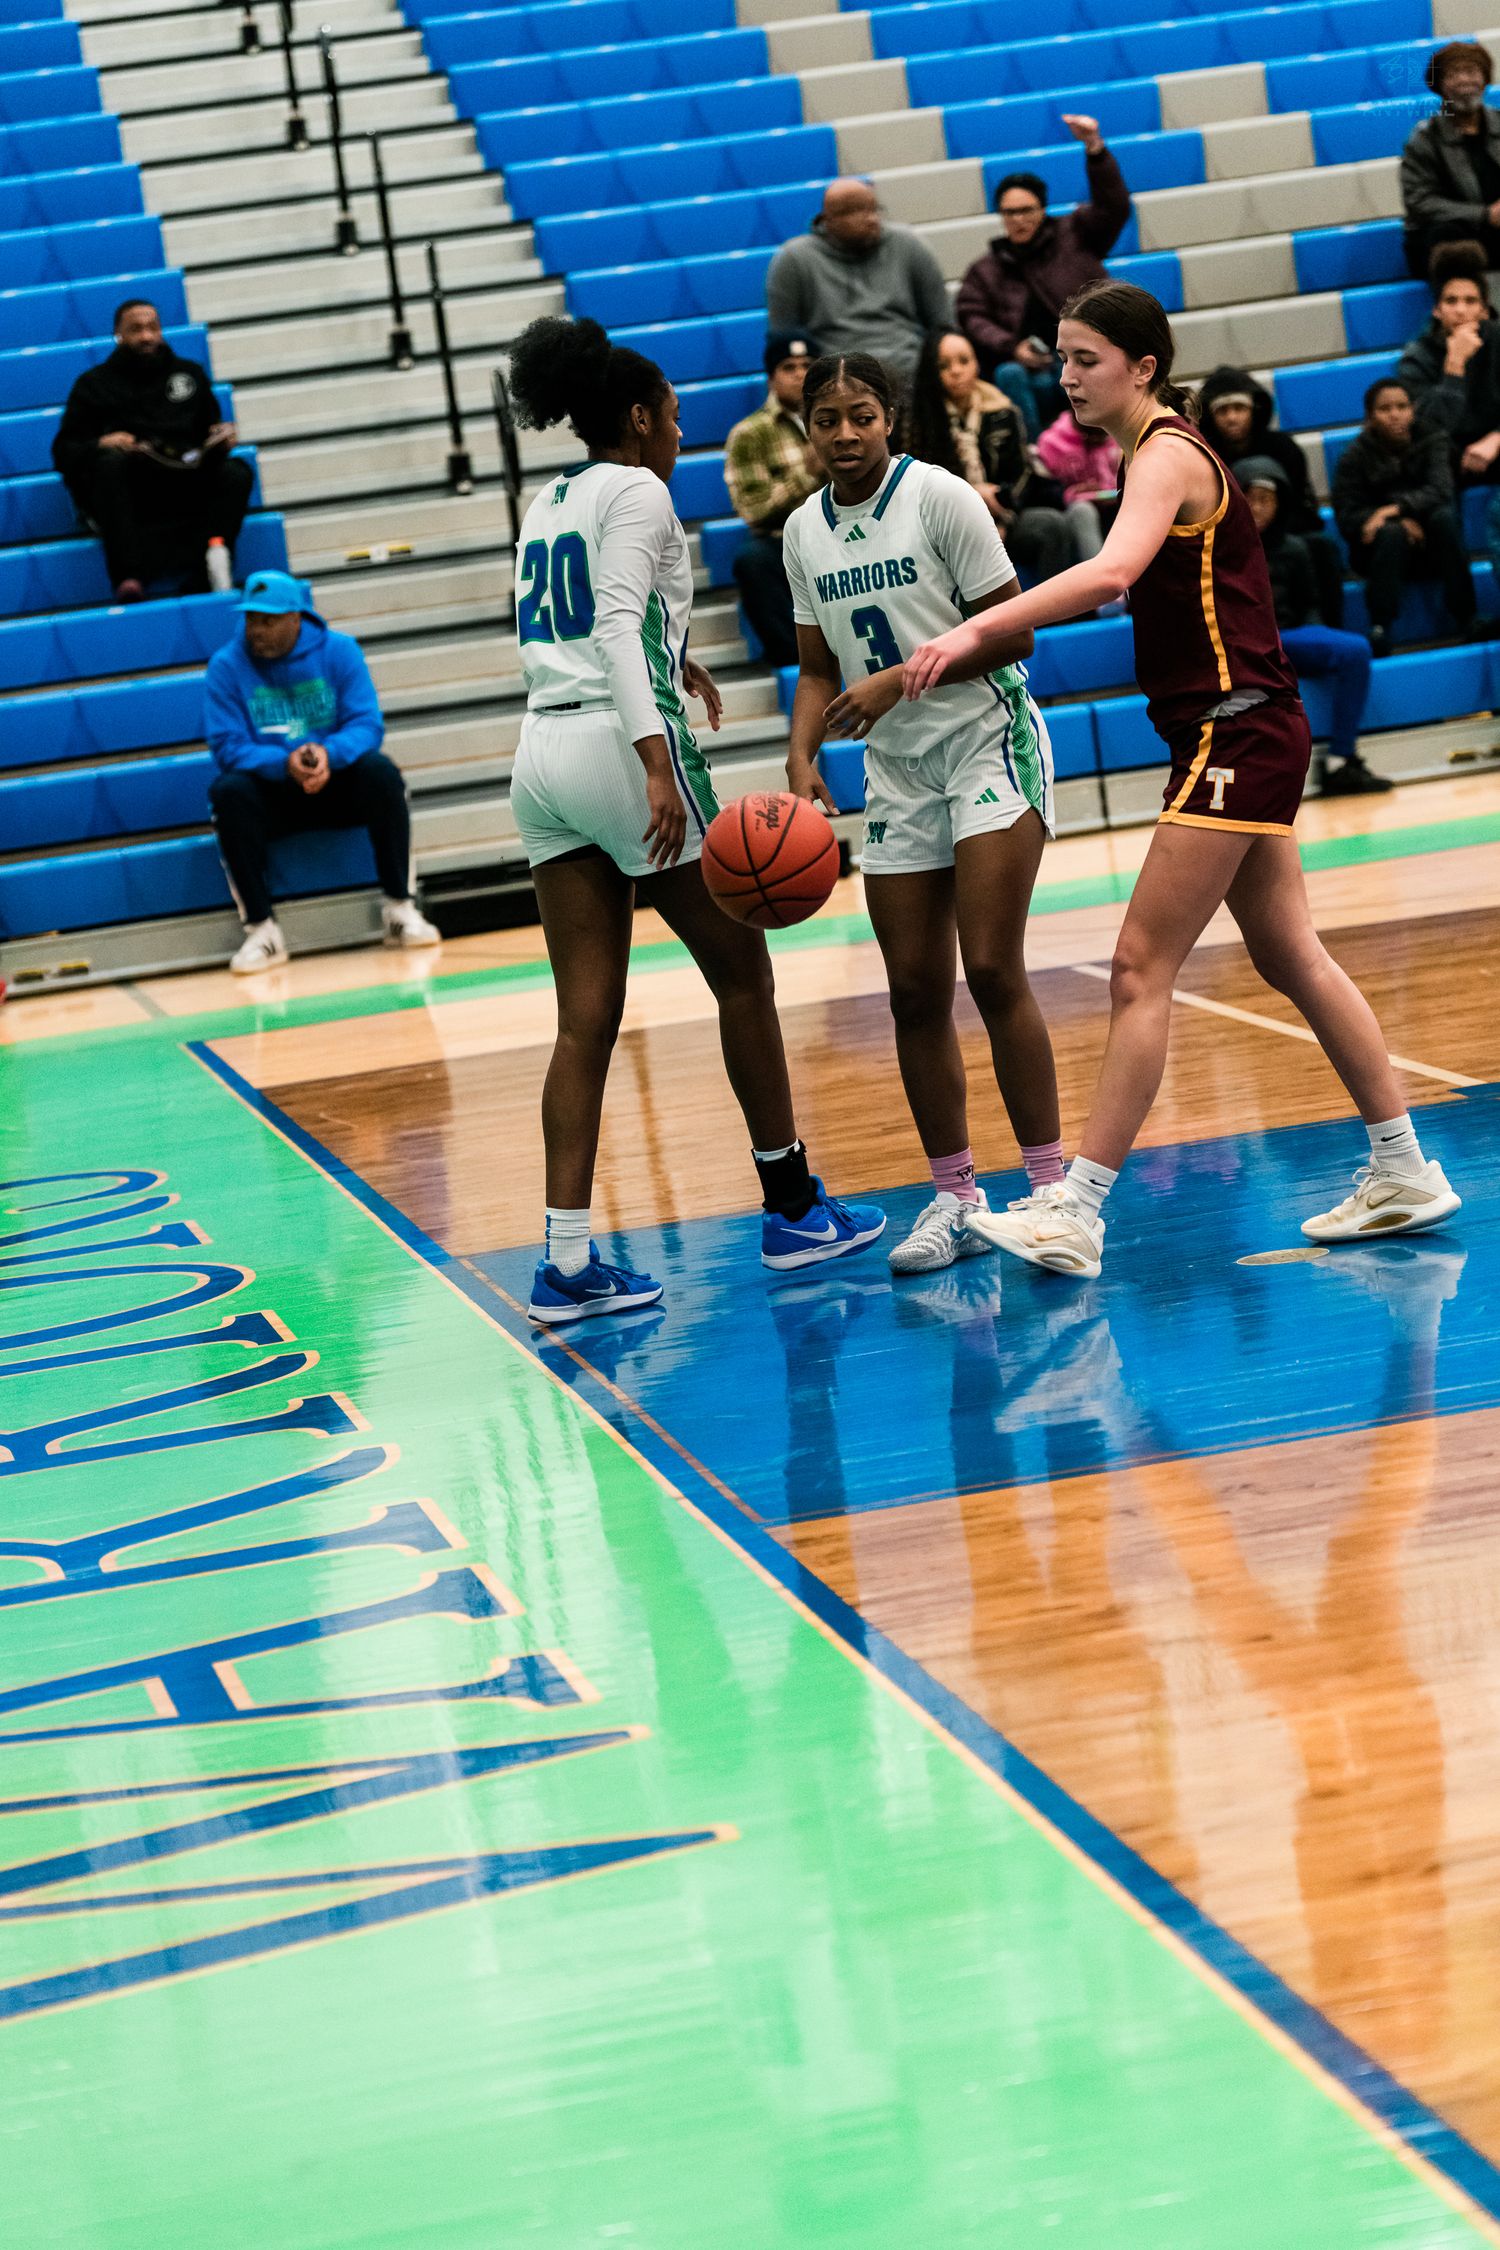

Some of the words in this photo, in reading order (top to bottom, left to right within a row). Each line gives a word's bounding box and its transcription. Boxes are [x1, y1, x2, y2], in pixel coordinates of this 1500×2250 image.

[518, 530, 596, 648] 20
[814, 556, 918, 604] WARRIORS
[850, 604, 904, 676] 3
[1205, 767, 1235, 811] T
[866, 819, 888, 844] W
